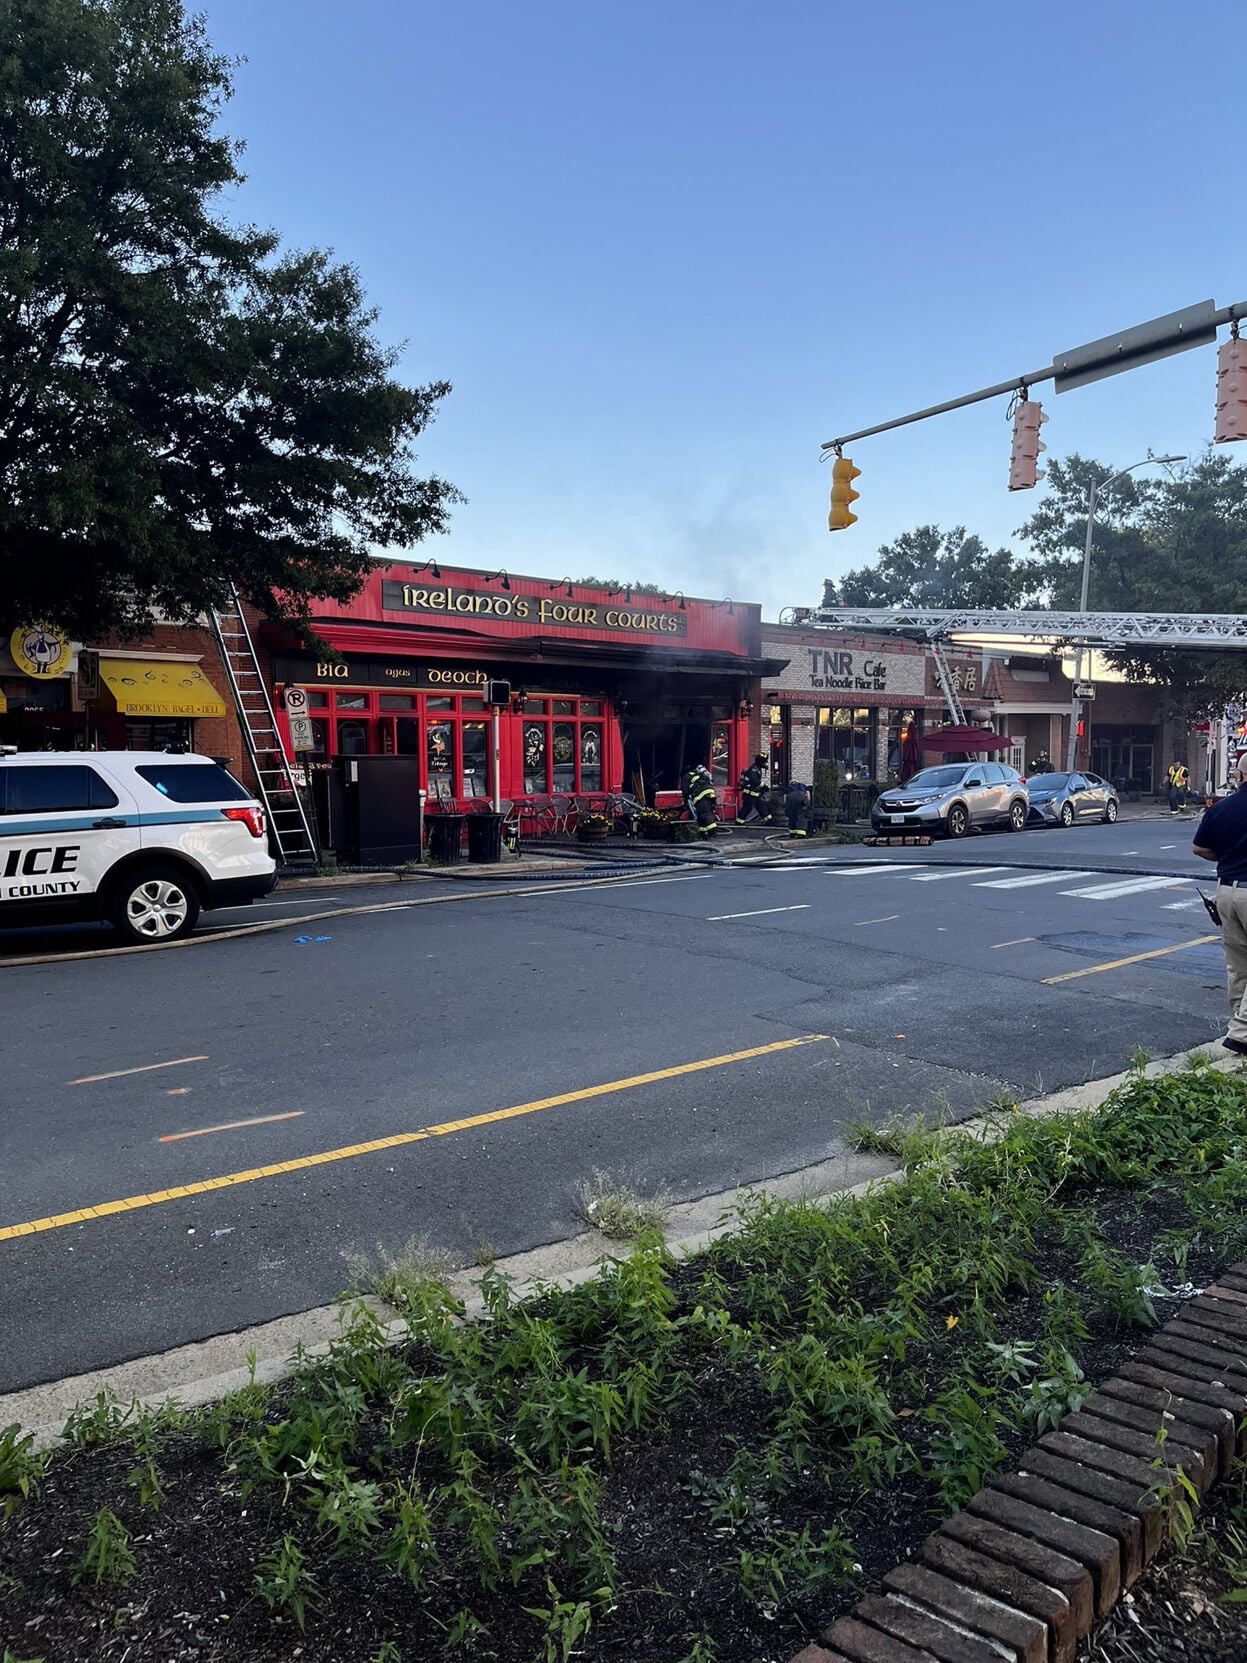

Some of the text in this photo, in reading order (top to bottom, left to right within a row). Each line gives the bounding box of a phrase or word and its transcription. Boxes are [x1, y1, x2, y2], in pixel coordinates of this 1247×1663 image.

[808, 648, 853, 676] TNR
[809, 674, 824, 687] Tea
[825, 675, 853, 688] Noodle
[126, 703, 168, 713] BROOKLYN
[0, 845, 81, 877] ICE
[9, 881, 81, 898] COUNTY
